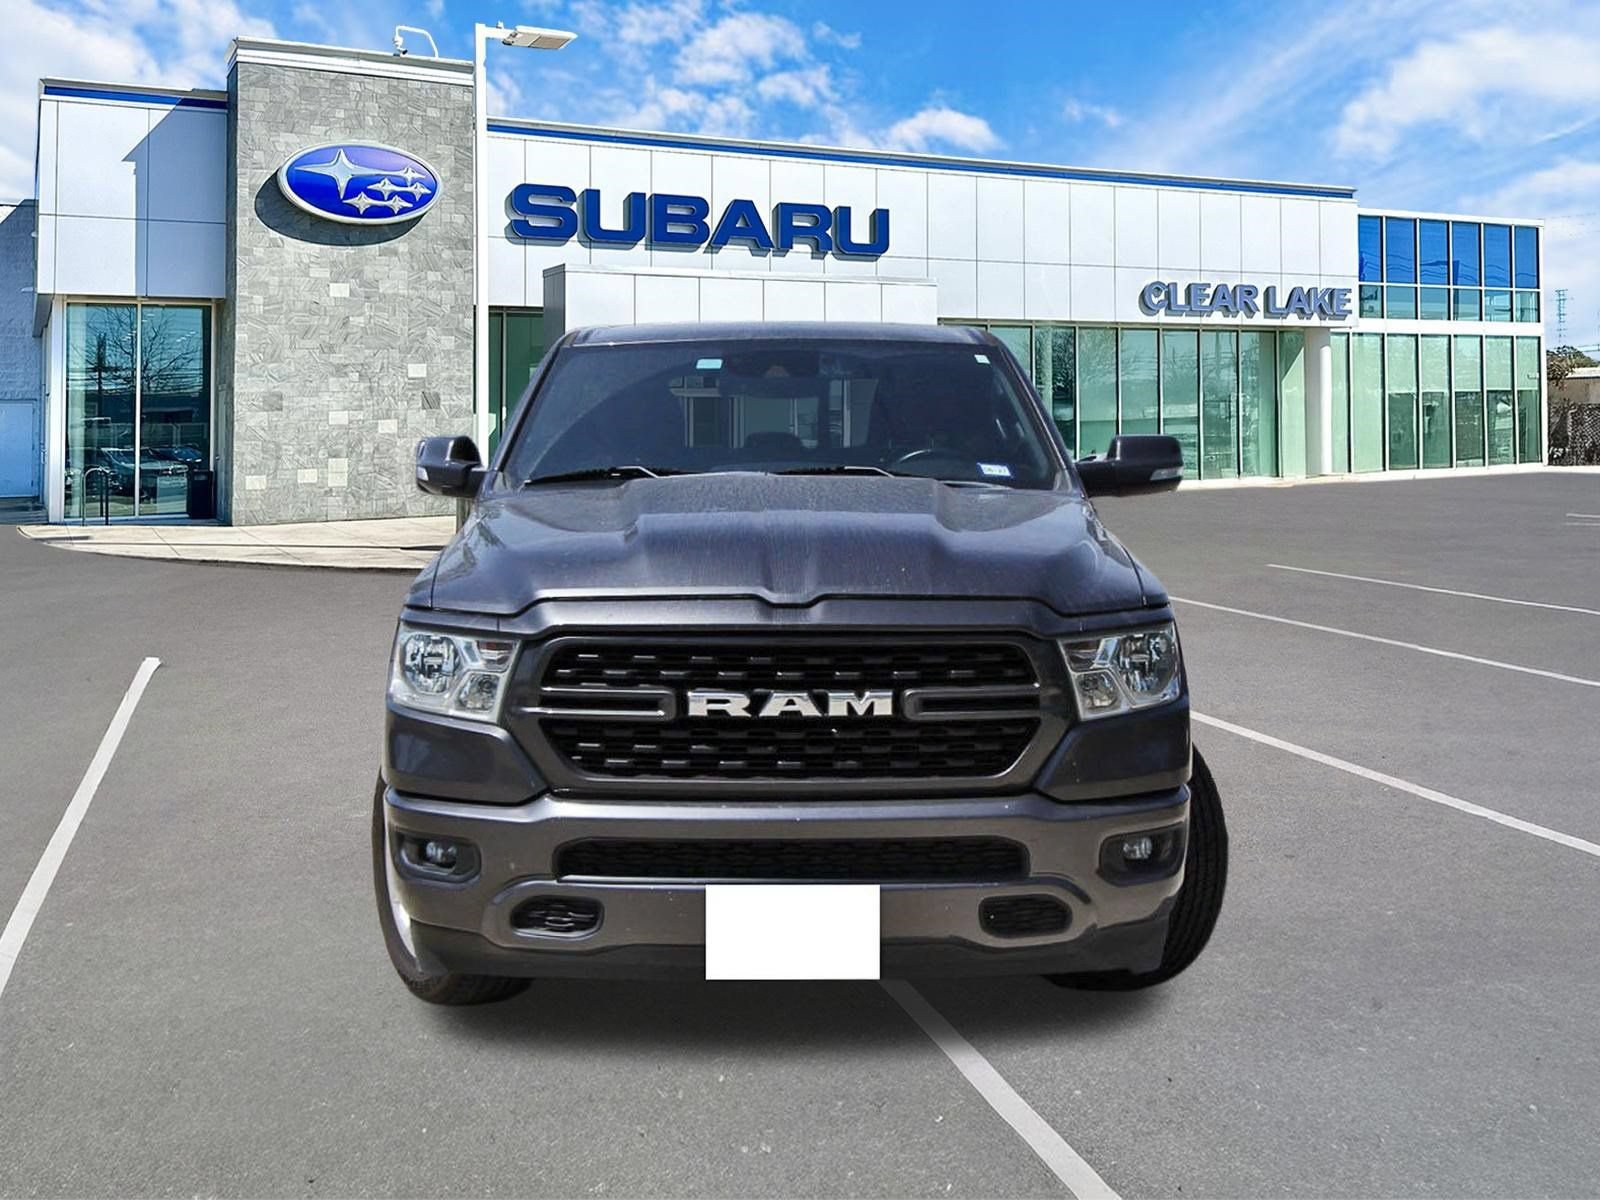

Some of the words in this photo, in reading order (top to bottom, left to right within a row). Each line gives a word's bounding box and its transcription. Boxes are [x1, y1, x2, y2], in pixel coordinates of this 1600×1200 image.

[506, 183, 889, 260] SUBARU
[1139, 281, 1259, 318] CLEAR
[1263, 285, 1352, 320] LAKE
[687, 689, 893, 717] RAM
